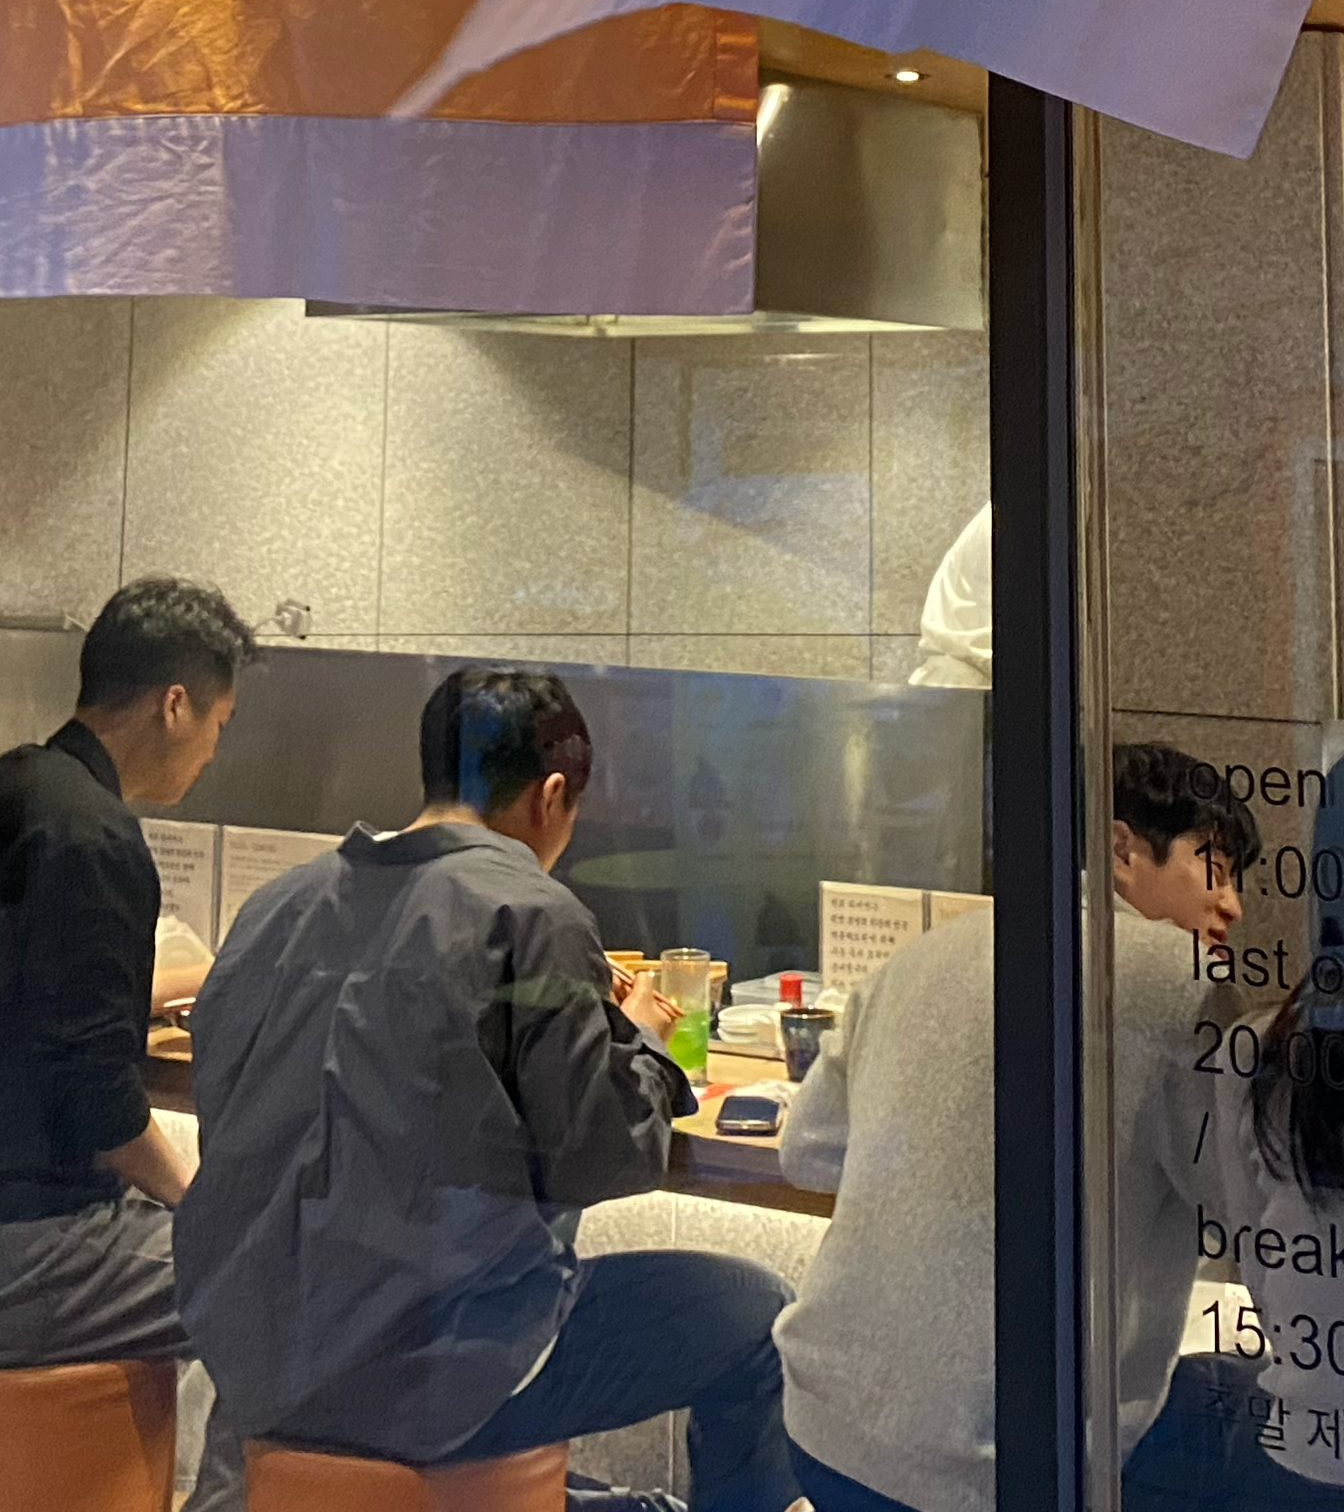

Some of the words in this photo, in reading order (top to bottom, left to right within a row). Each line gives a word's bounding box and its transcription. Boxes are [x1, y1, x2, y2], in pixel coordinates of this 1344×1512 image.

[1188, 761, 1328, 809] open
[1194, 840, 1343, 901] 11:00
[1193, 929, 1290, 988] last
